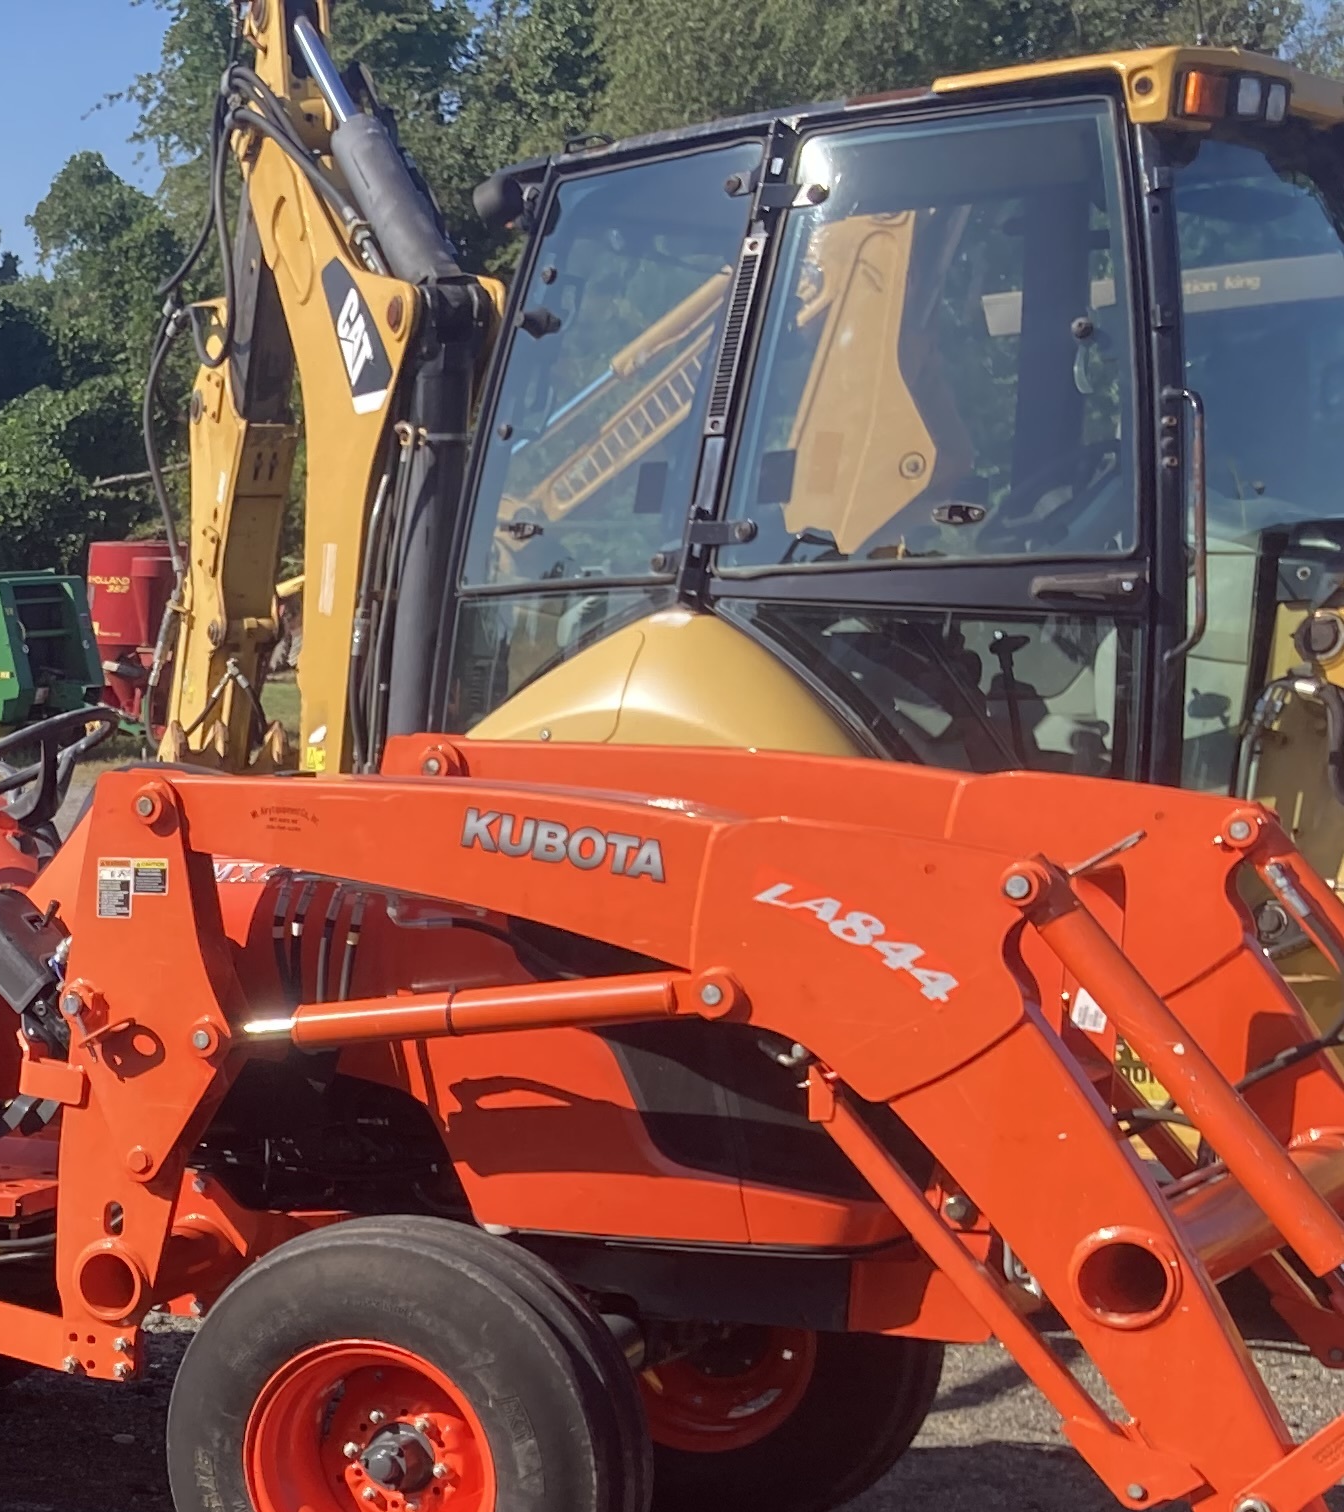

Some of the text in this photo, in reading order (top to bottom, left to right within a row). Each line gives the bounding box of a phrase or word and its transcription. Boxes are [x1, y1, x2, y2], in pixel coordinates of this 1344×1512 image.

[336, 288, 375, 387] CAT
[460, 806, 667, 884] KUBOTA
[752, 882, 960, 1003] LA844
